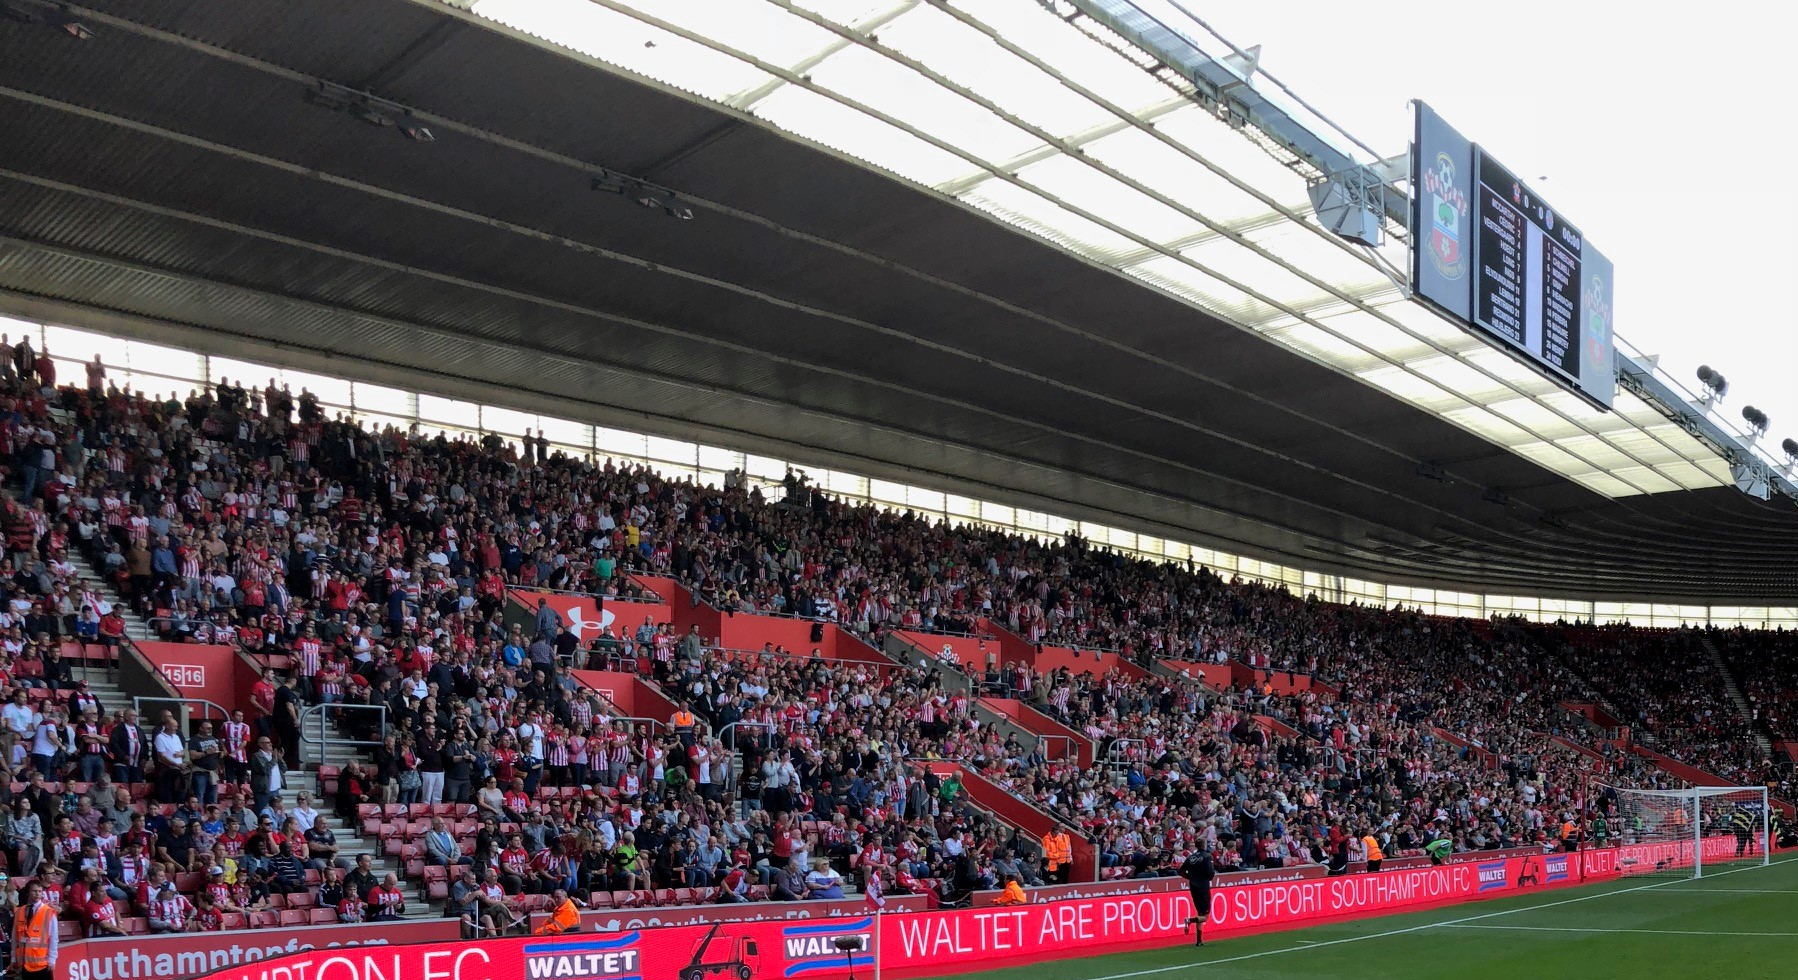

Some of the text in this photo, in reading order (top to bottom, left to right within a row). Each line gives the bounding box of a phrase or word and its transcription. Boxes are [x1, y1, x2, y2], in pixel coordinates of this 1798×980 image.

[185, 670, 202, 683] 16
[900, 910, 1028, 958] WALTET
[1038, 904, 1094, 944] ARE
[1104, 896, 1191, 936] PROUD
[1234, 882, 1325, 921] SUPPORT
[1332, 868, 1450, 910] SOUTHAMPTON
[1453, 866, 1470, 893] FC
[1478, 868, 1506, 883] WALTET
[1546, 862, 1567, 875] WALTET
[528, 949, 638, 980] WALTET
